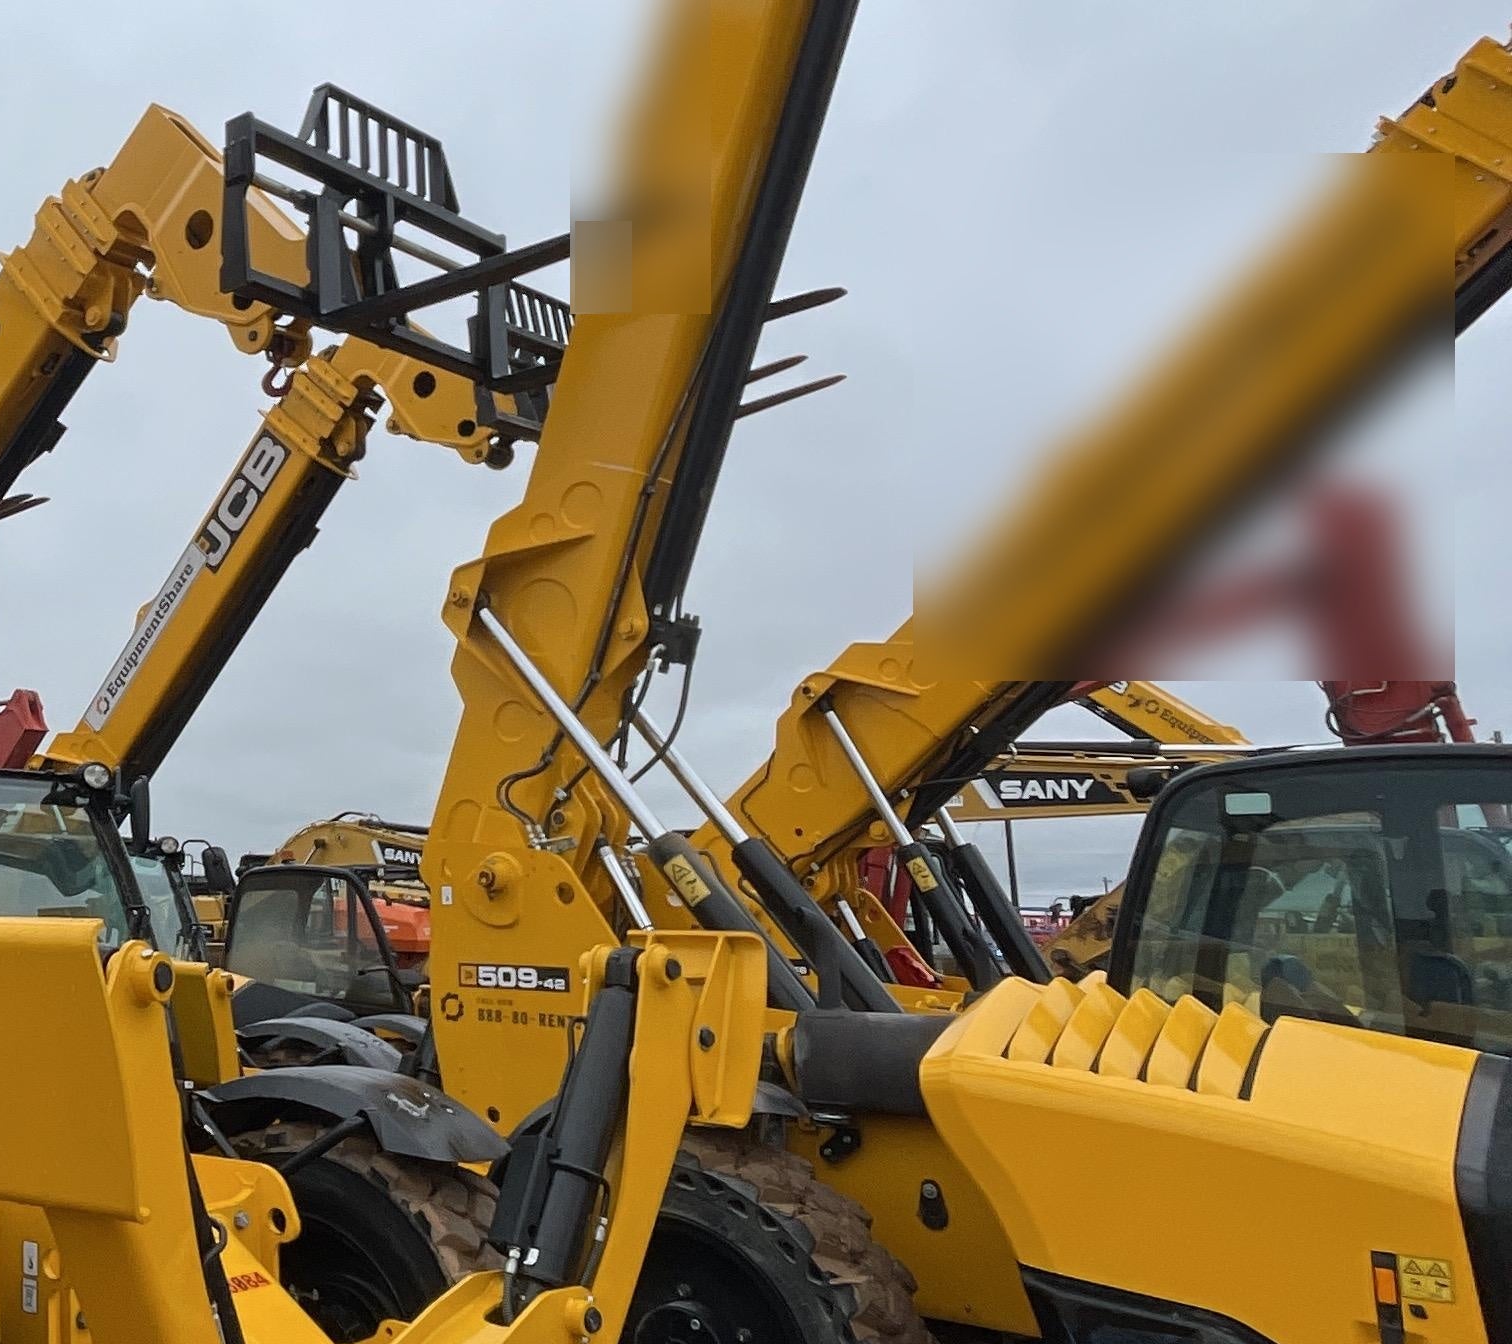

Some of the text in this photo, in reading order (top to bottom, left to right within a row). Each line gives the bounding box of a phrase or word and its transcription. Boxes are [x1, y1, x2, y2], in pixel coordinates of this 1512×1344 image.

[205, 436, 287, 567] JCB
[106, 563, 194, 699] EquipmentShare
[999, 778, 1095, 800] SANY
[477, 965, 566, 991] 509-42
[477, 1008, 580, 1029] 888-80-REN
